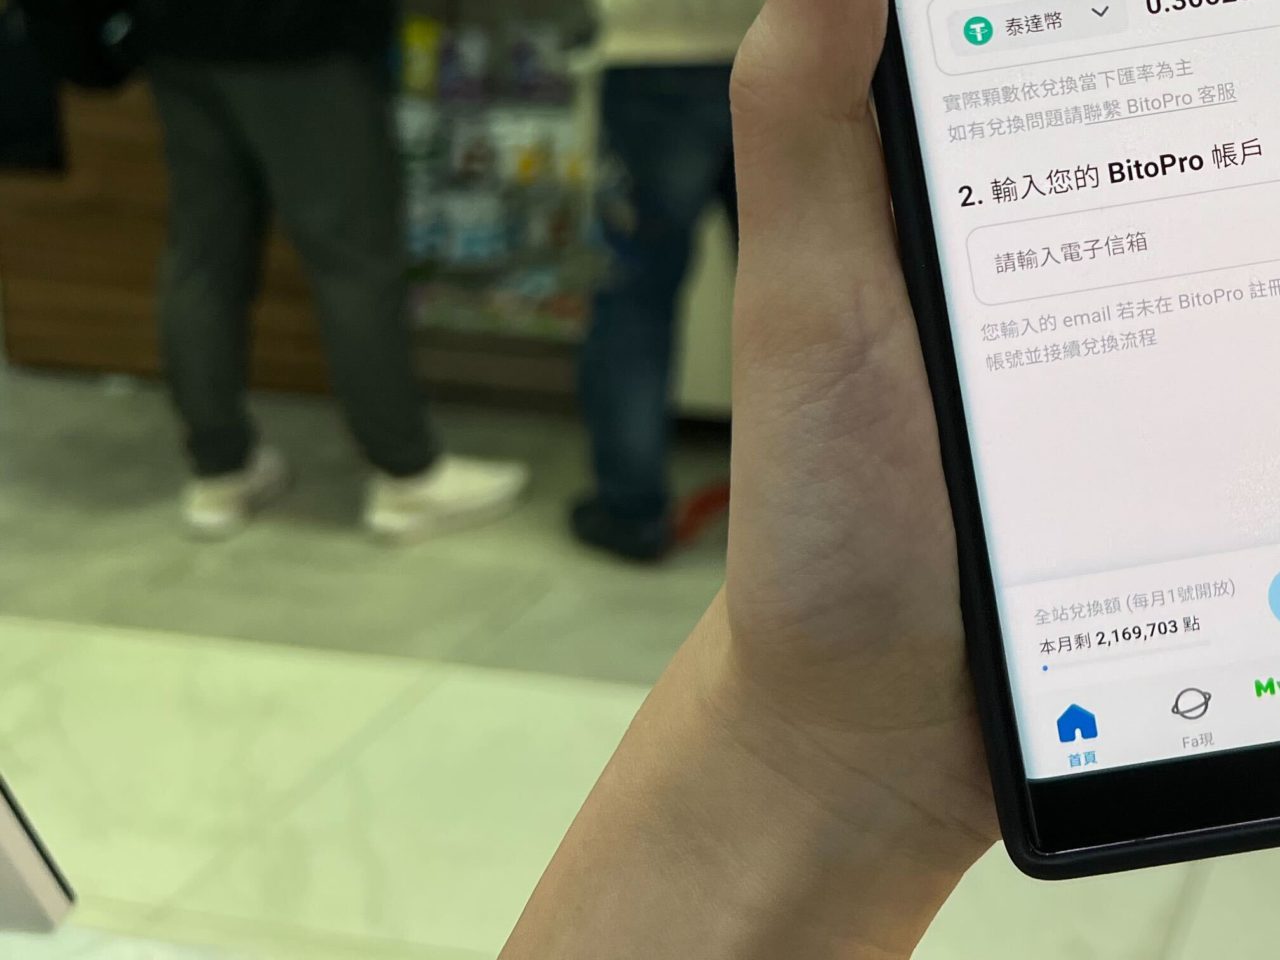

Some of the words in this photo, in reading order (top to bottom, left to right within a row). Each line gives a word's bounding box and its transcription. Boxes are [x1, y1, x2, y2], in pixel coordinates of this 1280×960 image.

[1005, 11, 1063, 37] 泰達幣
[942, 58, 1194, 113] 實際顆數依兌換當下匯率為主
[1127, 90, 1193, 115] BitoPro
[1198, 82, 1237, 105] 客服
[958, 184, 984, 208] 2.
[990, 161, 1100, 205] 輸入您的
[1108, 149, 1204, 186] BitoPro
[994, 231, 1148, 274] 請輸入電子信箱
[981, 314, 1057, 342] 您輸入的
[1063, 305, 1111, 329] email
[1117, 296, 1173, 321] 若未在
[1179, 288, 1244, 310] BitoPro
[986, 327, 1158, 371] 帳號並接續兌換流程
[1034, 596, 1121, 626] 全站兌換額
[1040, 632, 1092, 655] 本月剩
[1096, 620, 1179, 647] 2,169,703
[1183, 616, 1201, 632] 點
[1068, 750, 1098, 769] 首頁
[1182, 732, 1215, 750] Fa現
